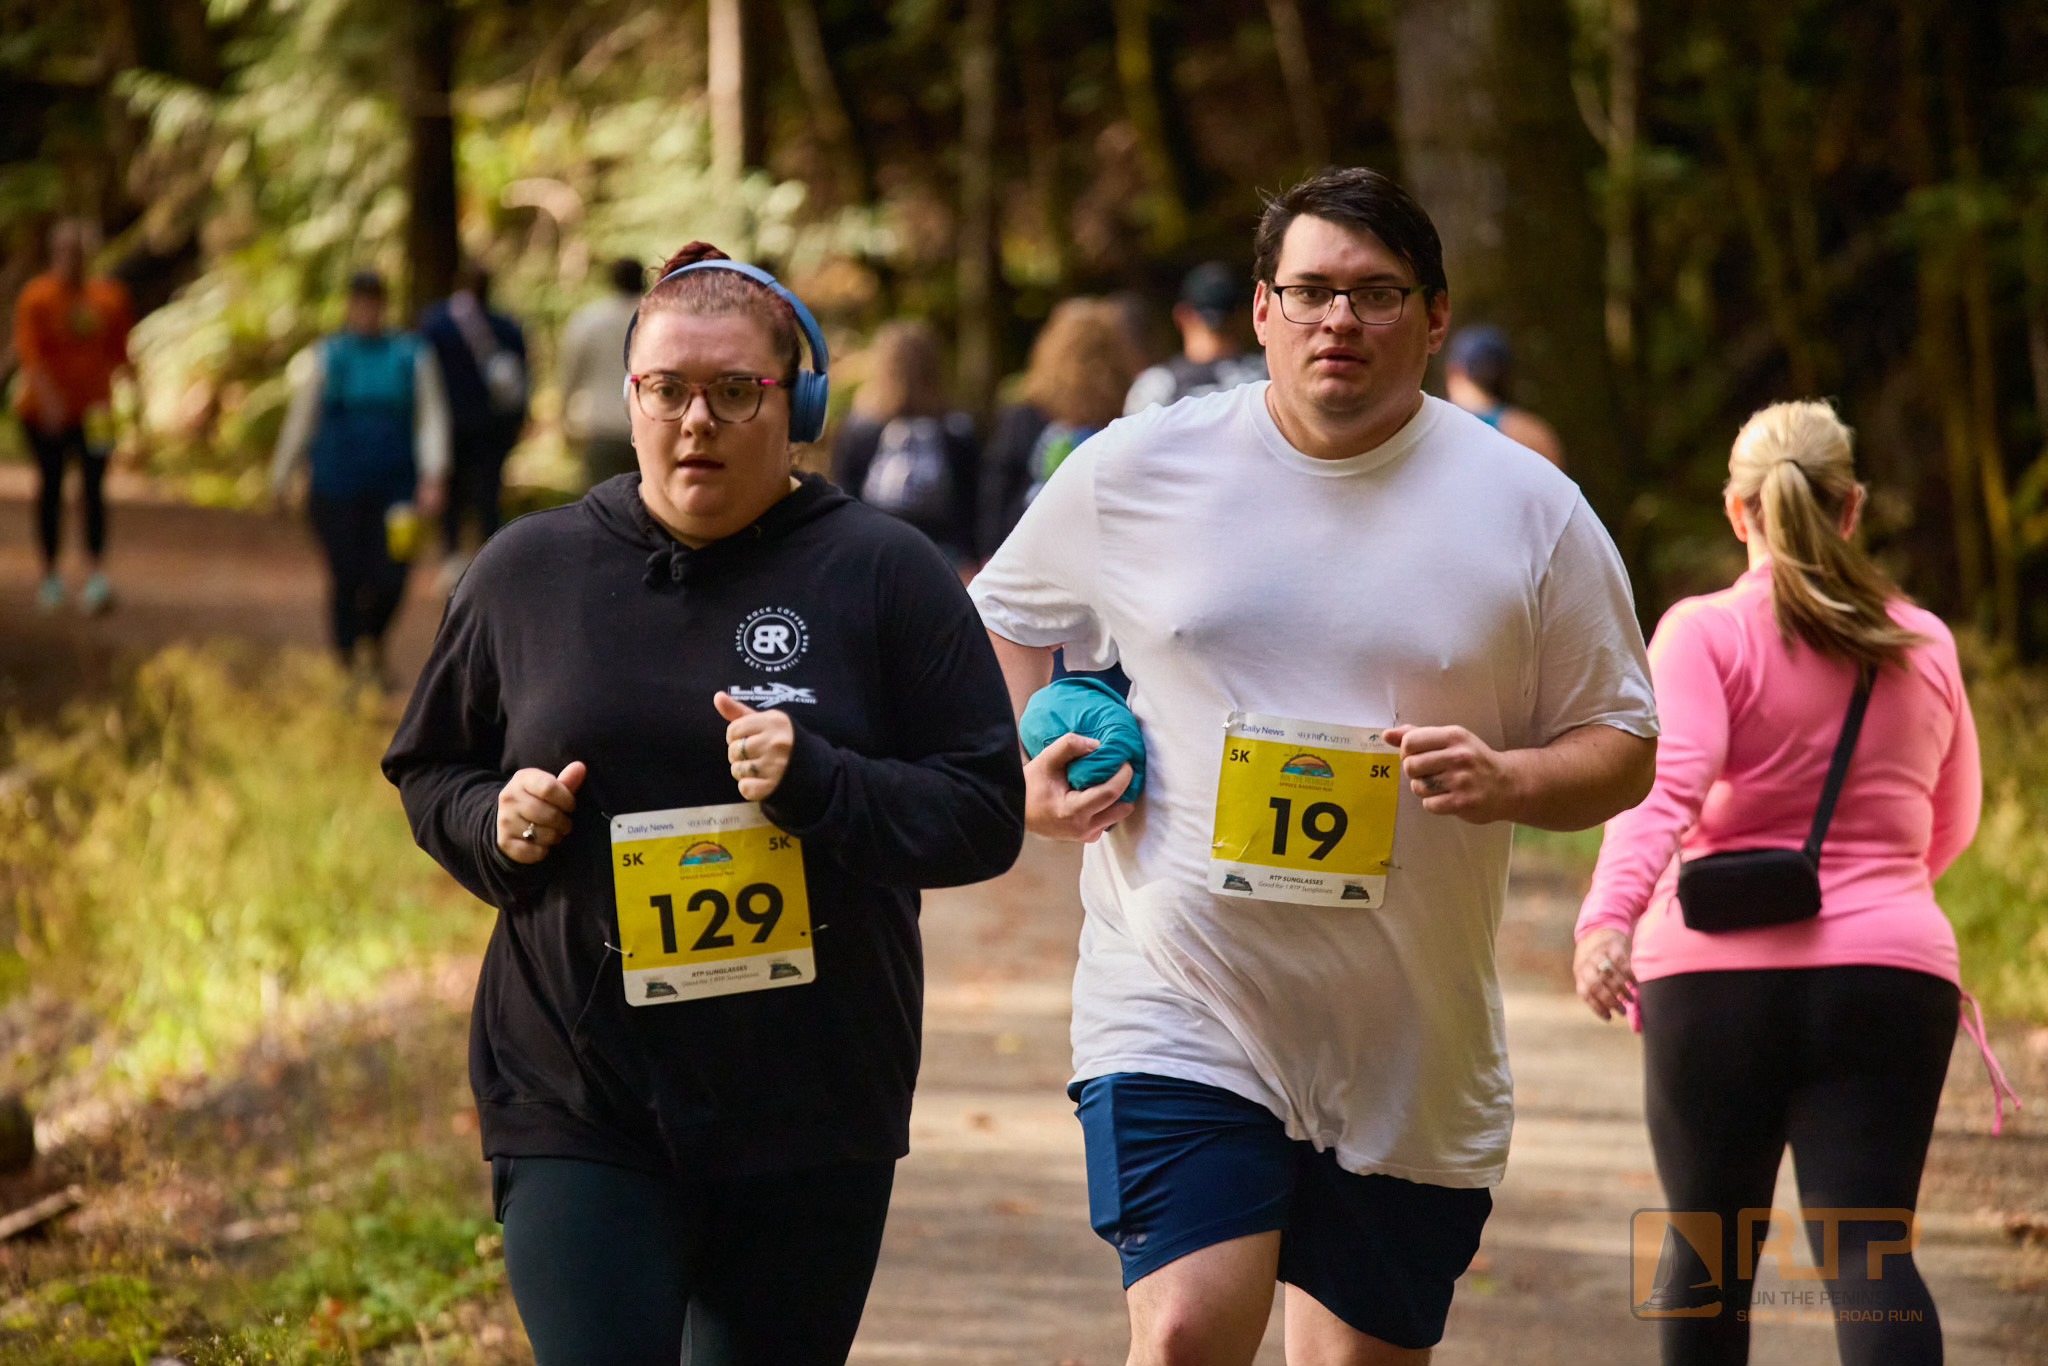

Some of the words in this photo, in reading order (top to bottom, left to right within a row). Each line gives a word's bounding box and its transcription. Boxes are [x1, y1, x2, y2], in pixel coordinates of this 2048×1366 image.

[746, 606, 772, 621] ROCK
[752, 625, 790, 654] BR
[1241, 723, 1260, 735] Daily
[1261, 726, 1285, 736] News
[1229, 749, 1250, 763] 5K
[1370, 765, 1390, 778] 5K
[627, 823, 648, 835] Daily
[649, 822, 674, 832] News
[1269, 797, 1348, 861] 19
[769, 836, 792, 850] 5K
[622, 852, 644, 867] 5K
[1283, 876, 1323, 886] SUNGLASSES
[649, 882, 784, 954] 129
[692, 970, 704, 978] RTP
[705, 964, 747, 976] SUNGLASSES
